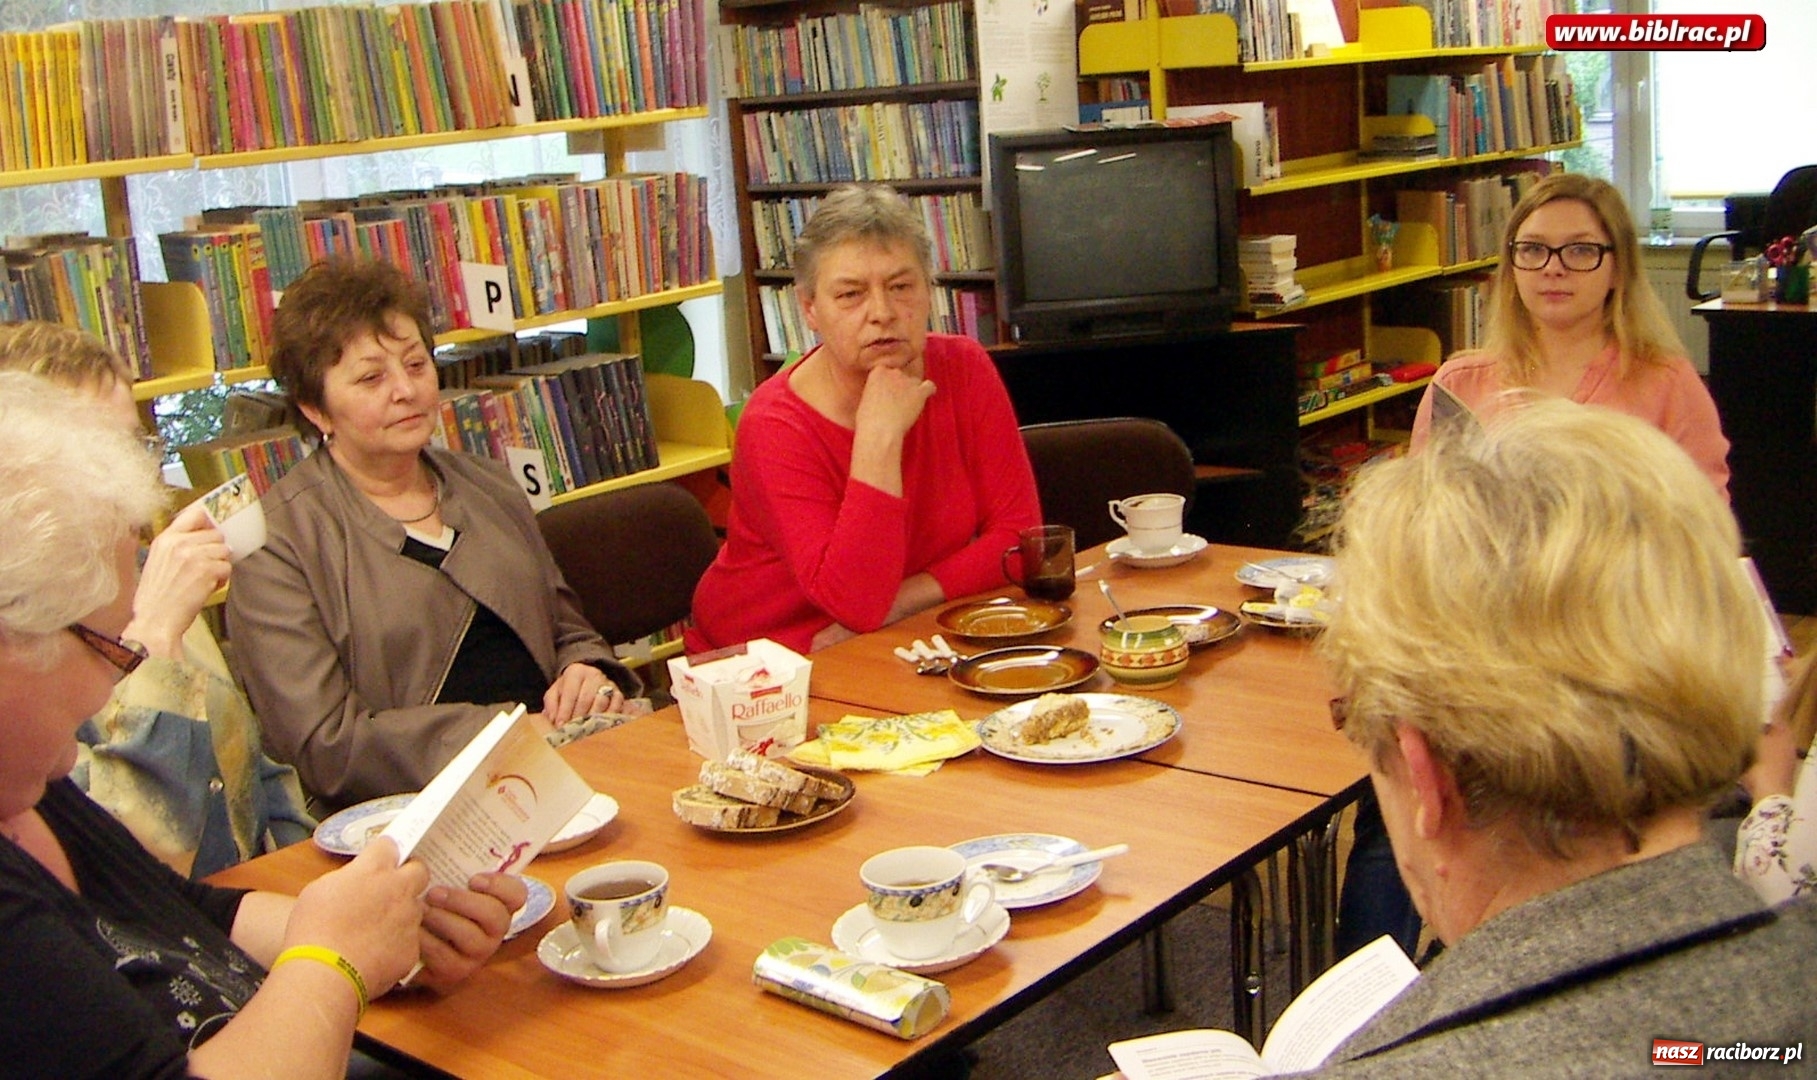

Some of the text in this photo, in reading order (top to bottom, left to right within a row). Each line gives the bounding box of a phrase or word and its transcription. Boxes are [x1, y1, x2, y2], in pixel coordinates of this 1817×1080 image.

[484, 280, 502, 314] P
[523, 463, 541, 496] S
[731, 692, 802, 721] Raffaello
